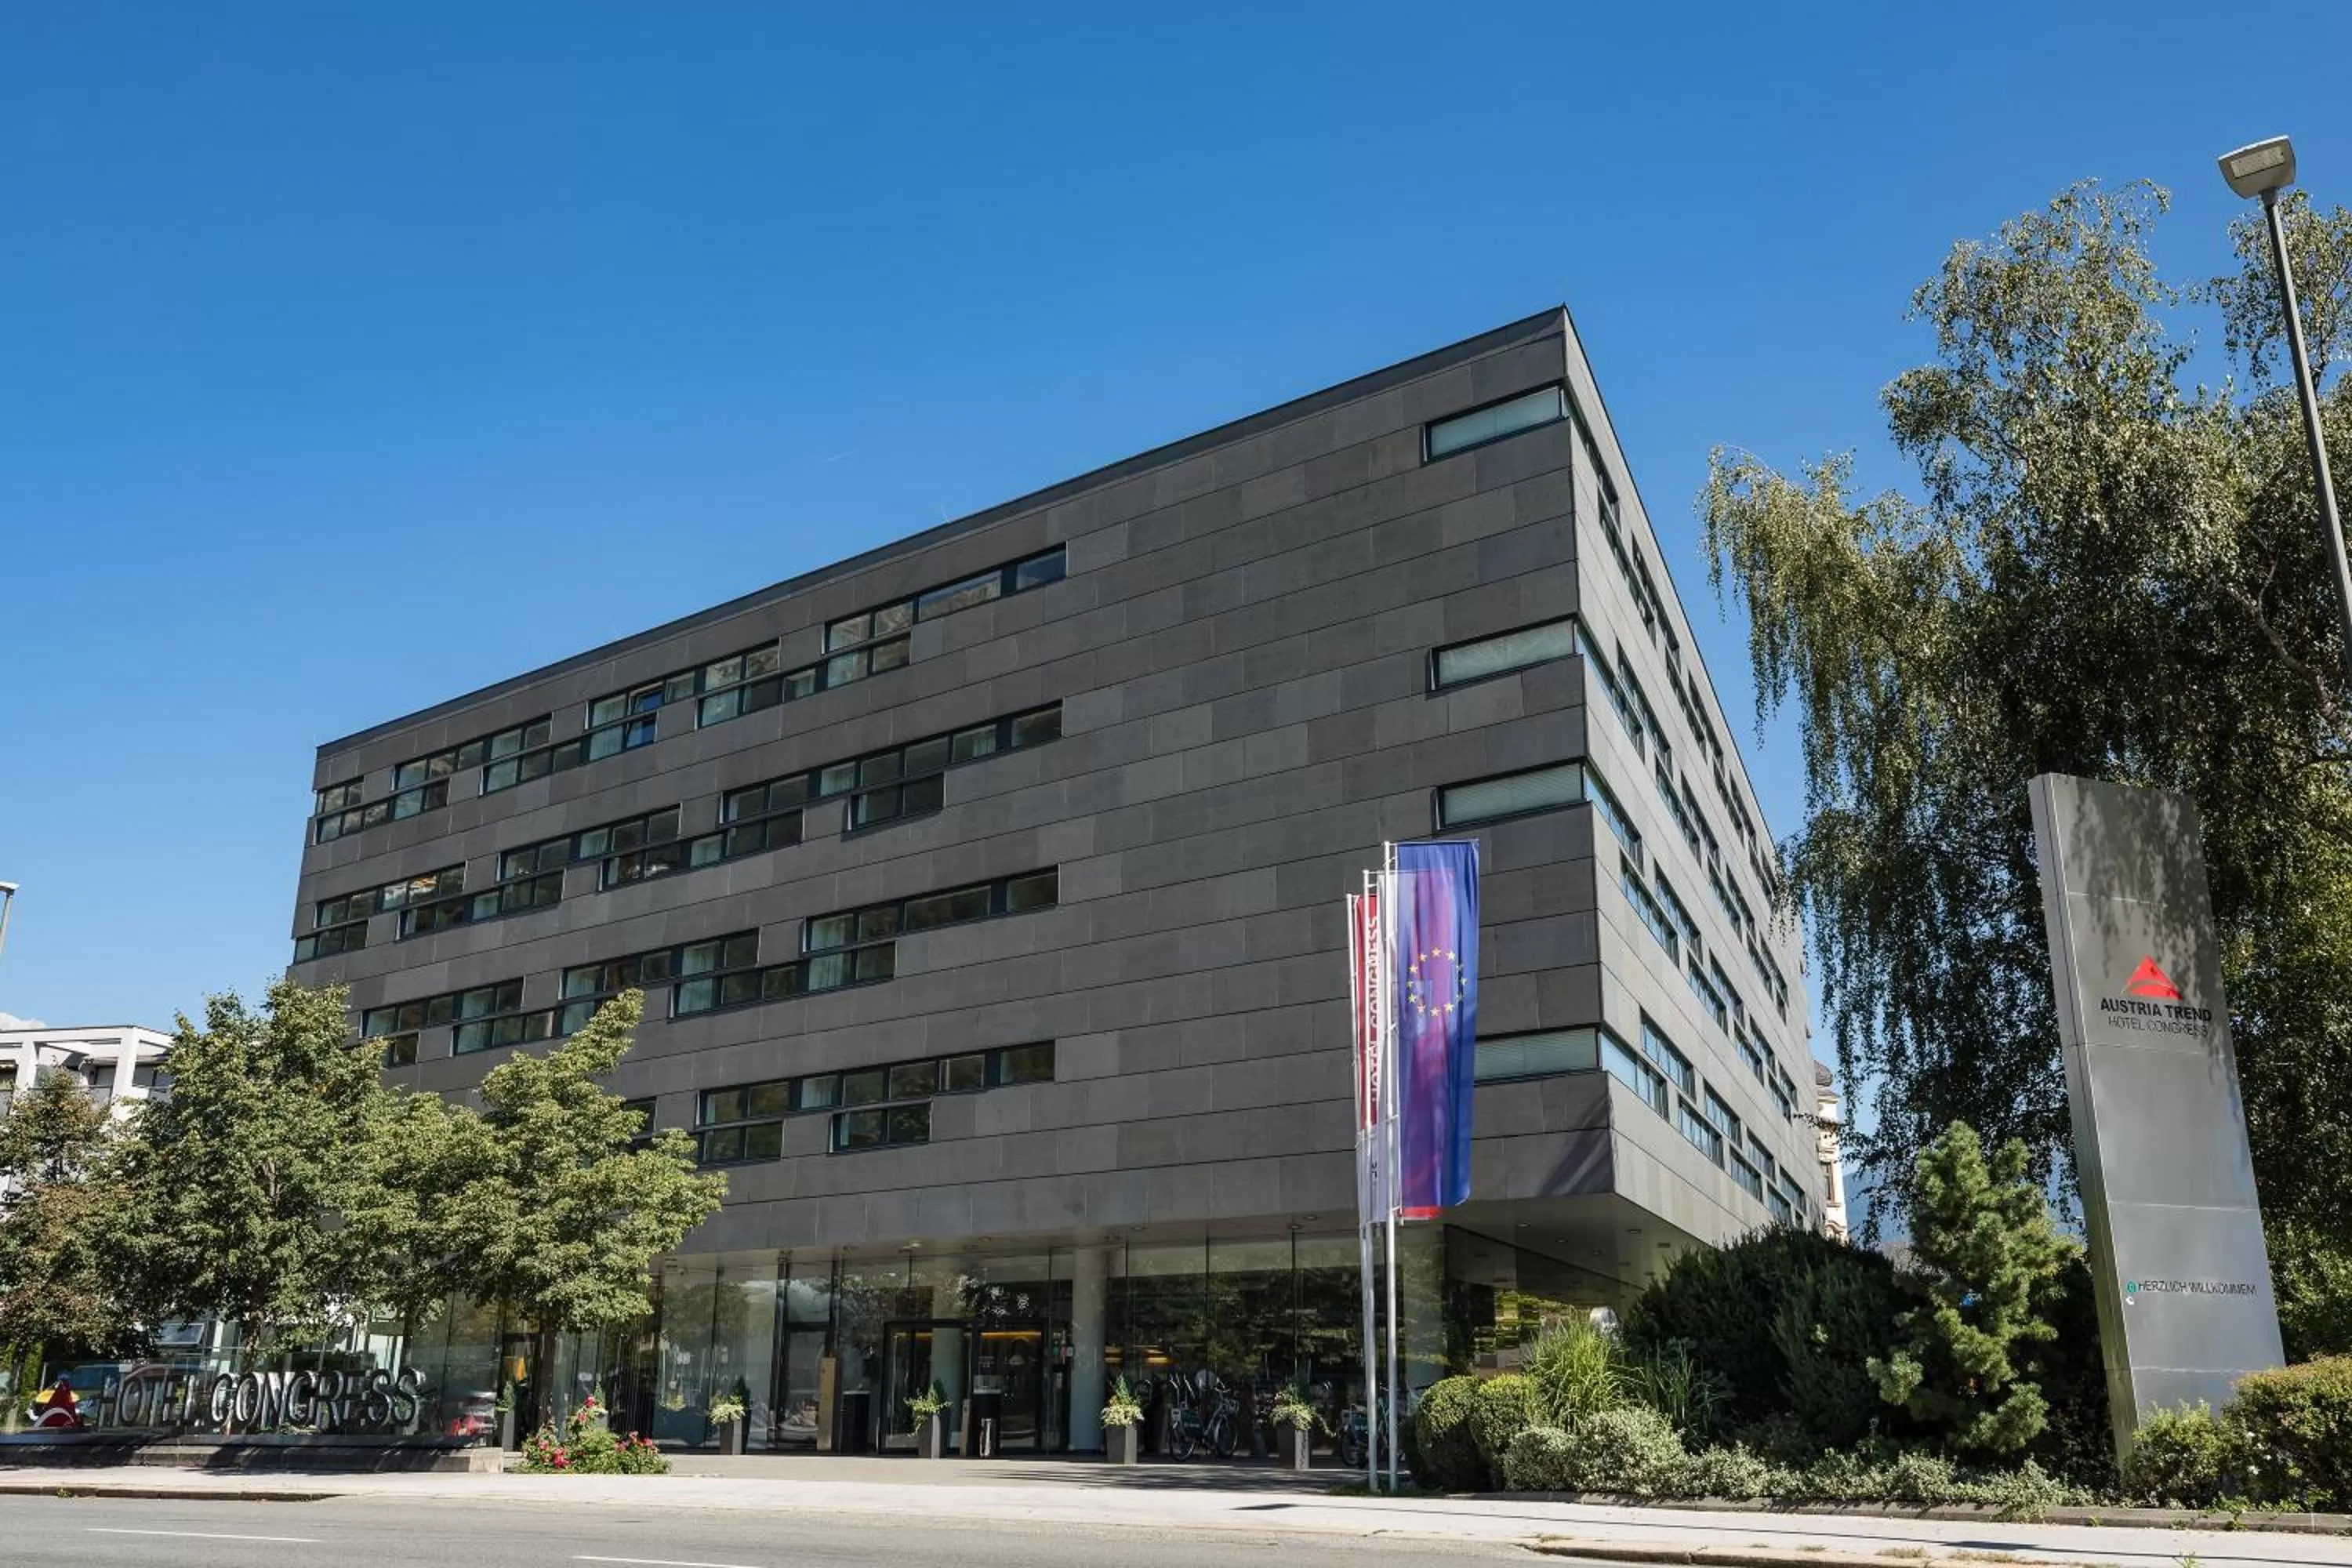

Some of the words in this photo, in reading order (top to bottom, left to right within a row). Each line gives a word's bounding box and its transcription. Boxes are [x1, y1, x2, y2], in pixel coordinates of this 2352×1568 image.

[2100, 997, 2162, 1018] AUSTRIA
[2164, 1004, 2212, 1022] TREND
[2108, 1016, 2145, 1031] HOTEL
[2146, 1021, 2209, 1037] CONGRESS
[2138, 1280, 2187, 1293] HERZLICH
[2187, 1282, 2256, 1294] WILLKOMMEN
[97, 1370, 206, 1429] HOTEL
[210, 1368, 423, 1429] CONGRESS
